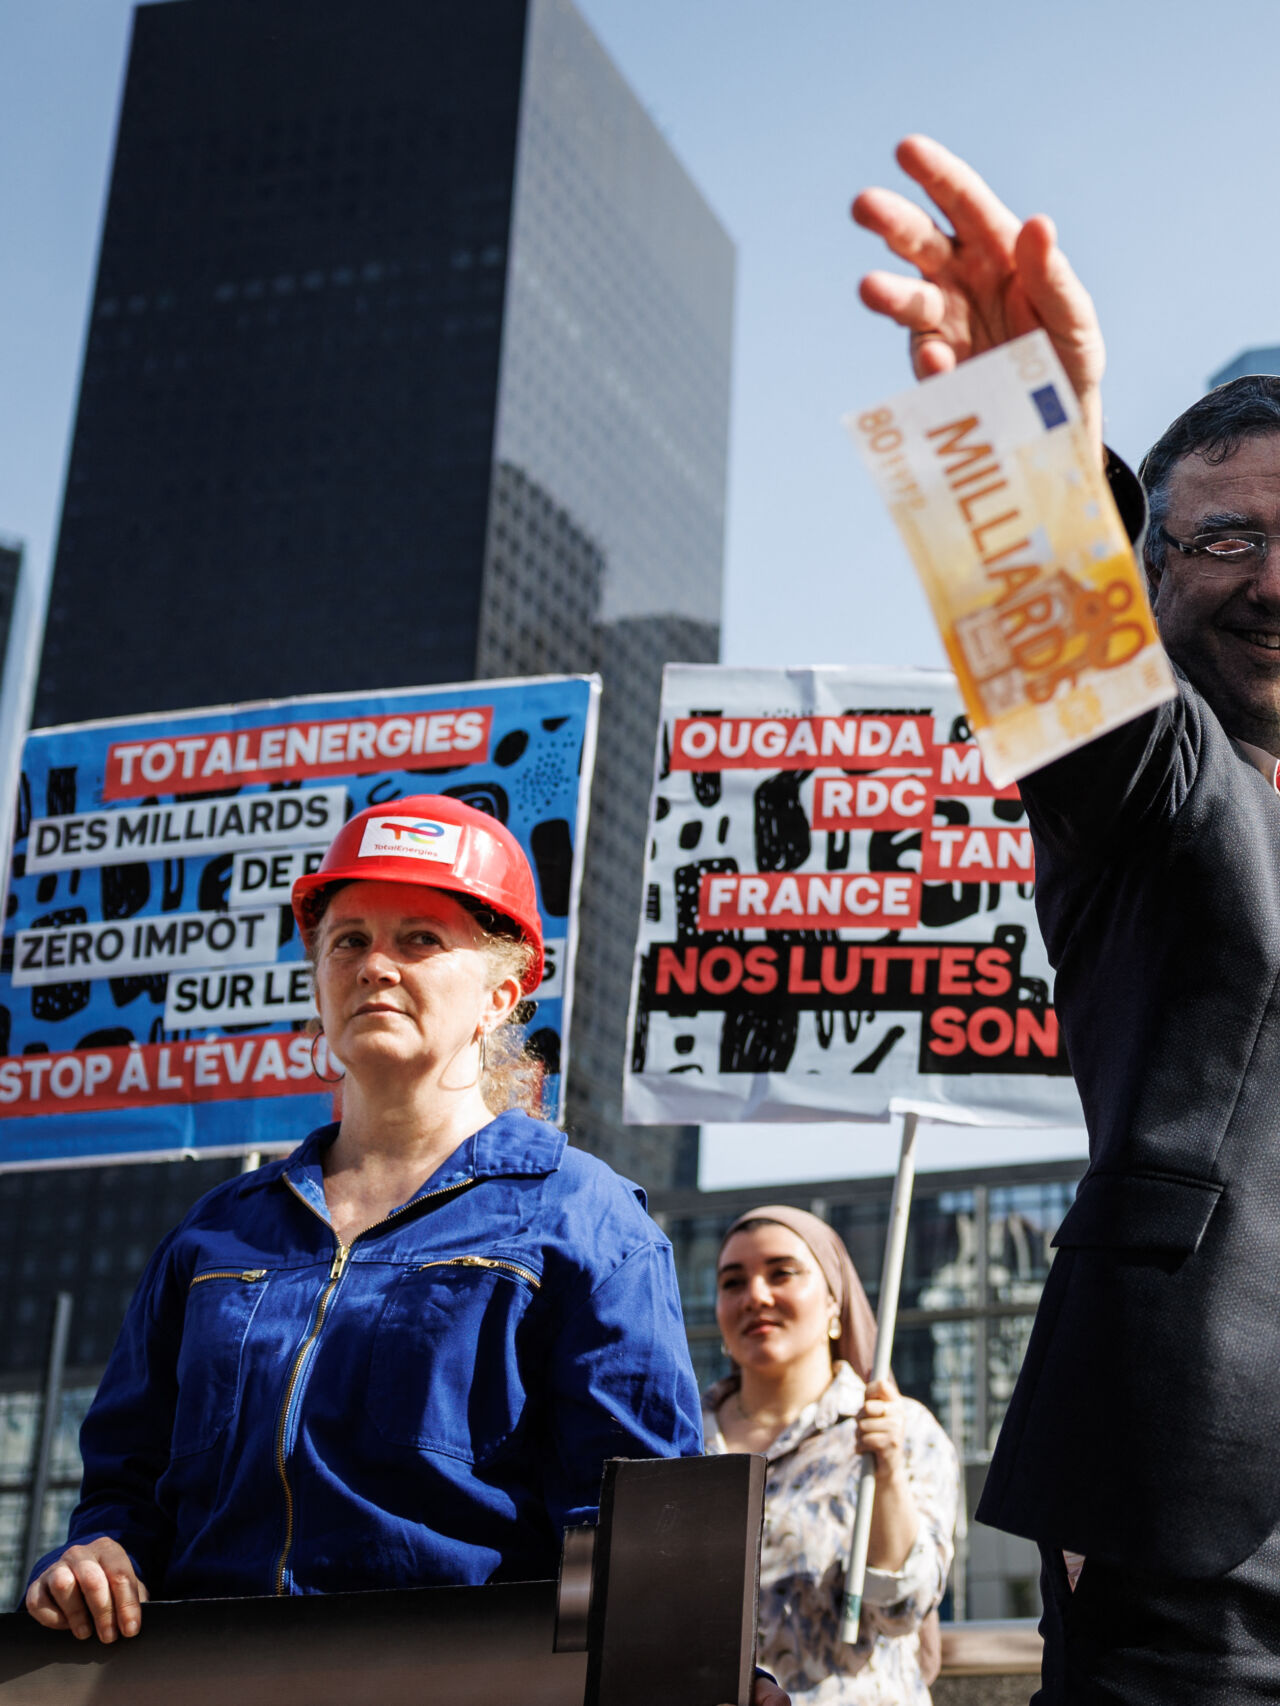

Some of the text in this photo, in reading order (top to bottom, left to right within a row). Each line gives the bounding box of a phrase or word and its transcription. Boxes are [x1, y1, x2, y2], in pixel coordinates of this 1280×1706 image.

[113, 711, 485, 786] TOTALENERGIES
[680, 719, 925, 759] OUGANDA
[820, 779, 927, 819] RDC
[35, 795, 331, 859] DES MILLIARDS
[373, 843, 439, 857] TotalEnergies
[929, 829, 1034, 870] TAN
[240, 855, 293, 892] DE
[707, 877, 914, 917] FRANCE
[21, 904, 265, 970] ZÉRO IMPÔT
[655, 945, 1013, 997] NOS LUTTES
[174, 972, 256, 1014] SUR
[0, 1053, 113, 1103] STOP
[117, 1040, 149, 1093] À
